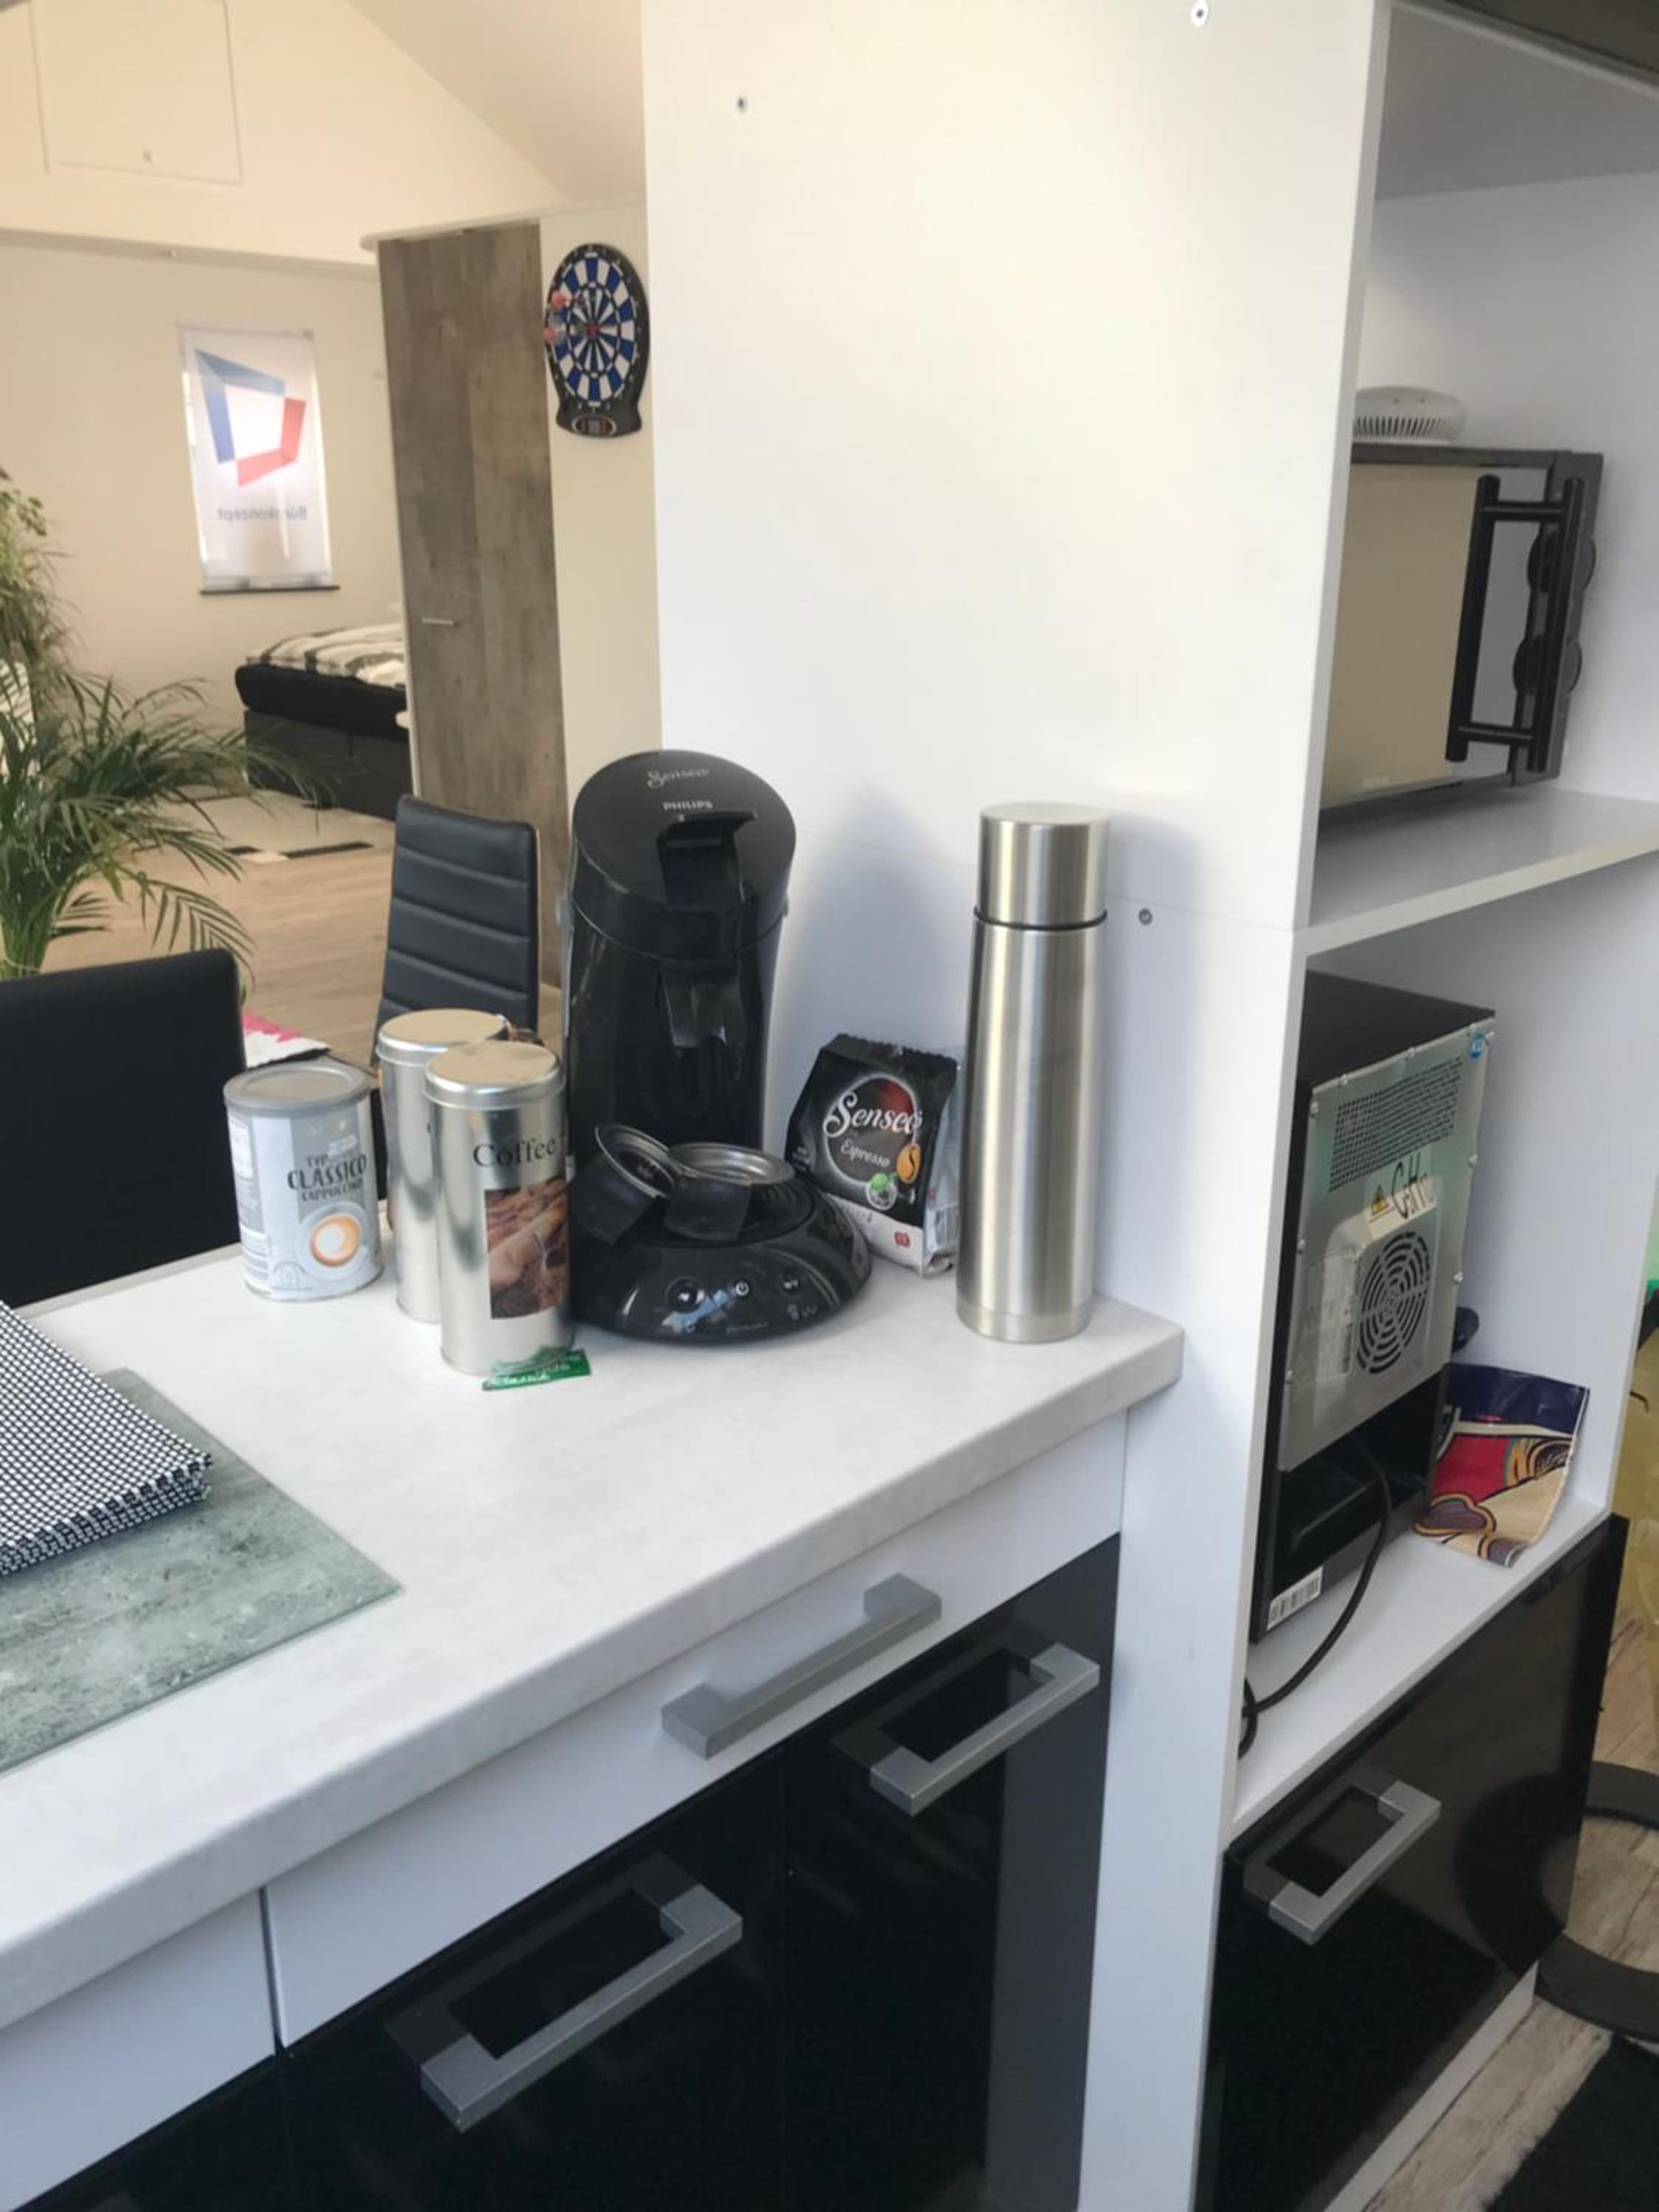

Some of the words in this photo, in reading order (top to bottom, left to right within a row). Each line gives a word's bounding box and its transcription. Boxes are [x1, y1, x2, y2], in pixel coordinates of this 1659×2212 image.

[662, 801, 713, 811] PHILIPS
[822, 1091, 922, 1138] Senseo
[472, 1138, 556, 1167] Coffee
[840, 1139, 890, 1168] Espresso
[286, 1153, 367, 1190] CLASSICO
[300, 1176, 365, 1202] CAPPUCCINO
